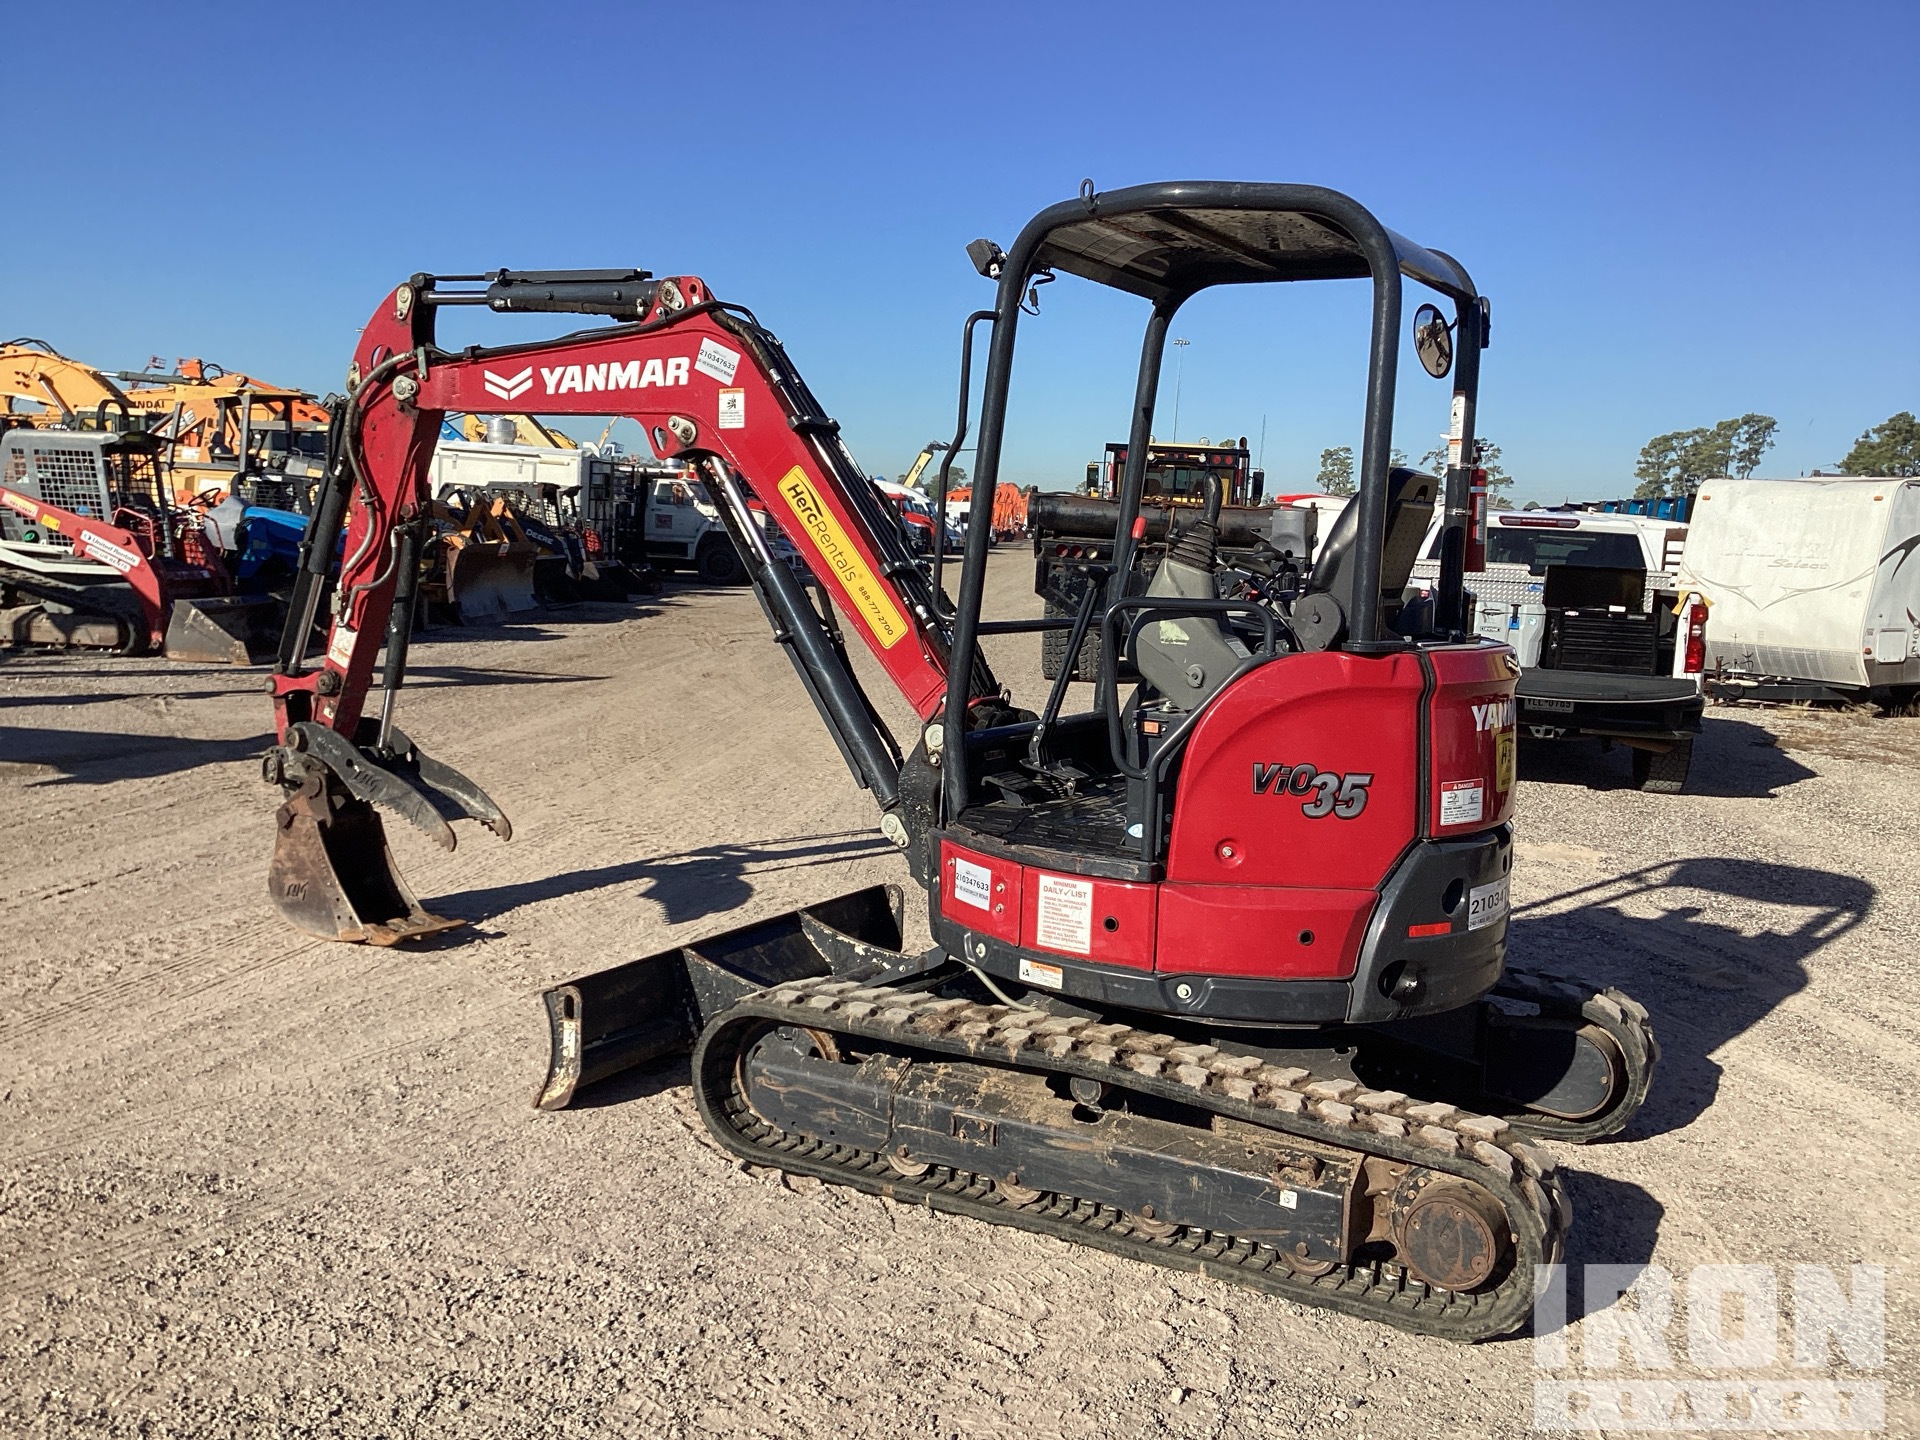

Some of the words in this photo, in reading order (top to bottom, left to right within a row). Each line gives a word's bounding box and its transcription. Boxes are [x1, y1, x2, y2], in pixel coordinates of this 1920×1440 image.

[700, 349, 736, 371] 210347633
[540, 357, 691, 395] YANMAR
[135, 400, 165, 409] NDAI
[526, 528, 554, 544] DEERE
[92, 537, 114, 551] United
[113, 548, 136, 563] Rentals
[1767, 558, 1829, 570] Select
[858, 586, 894, 636] 888-777-2700
[956, 872, 989, 892] 210347633
[1053, 880, 1077, 888] MINIMUM
[1043, 885, 1063, 894] DAILY
[1070, 890, 1087, 899] LIST
